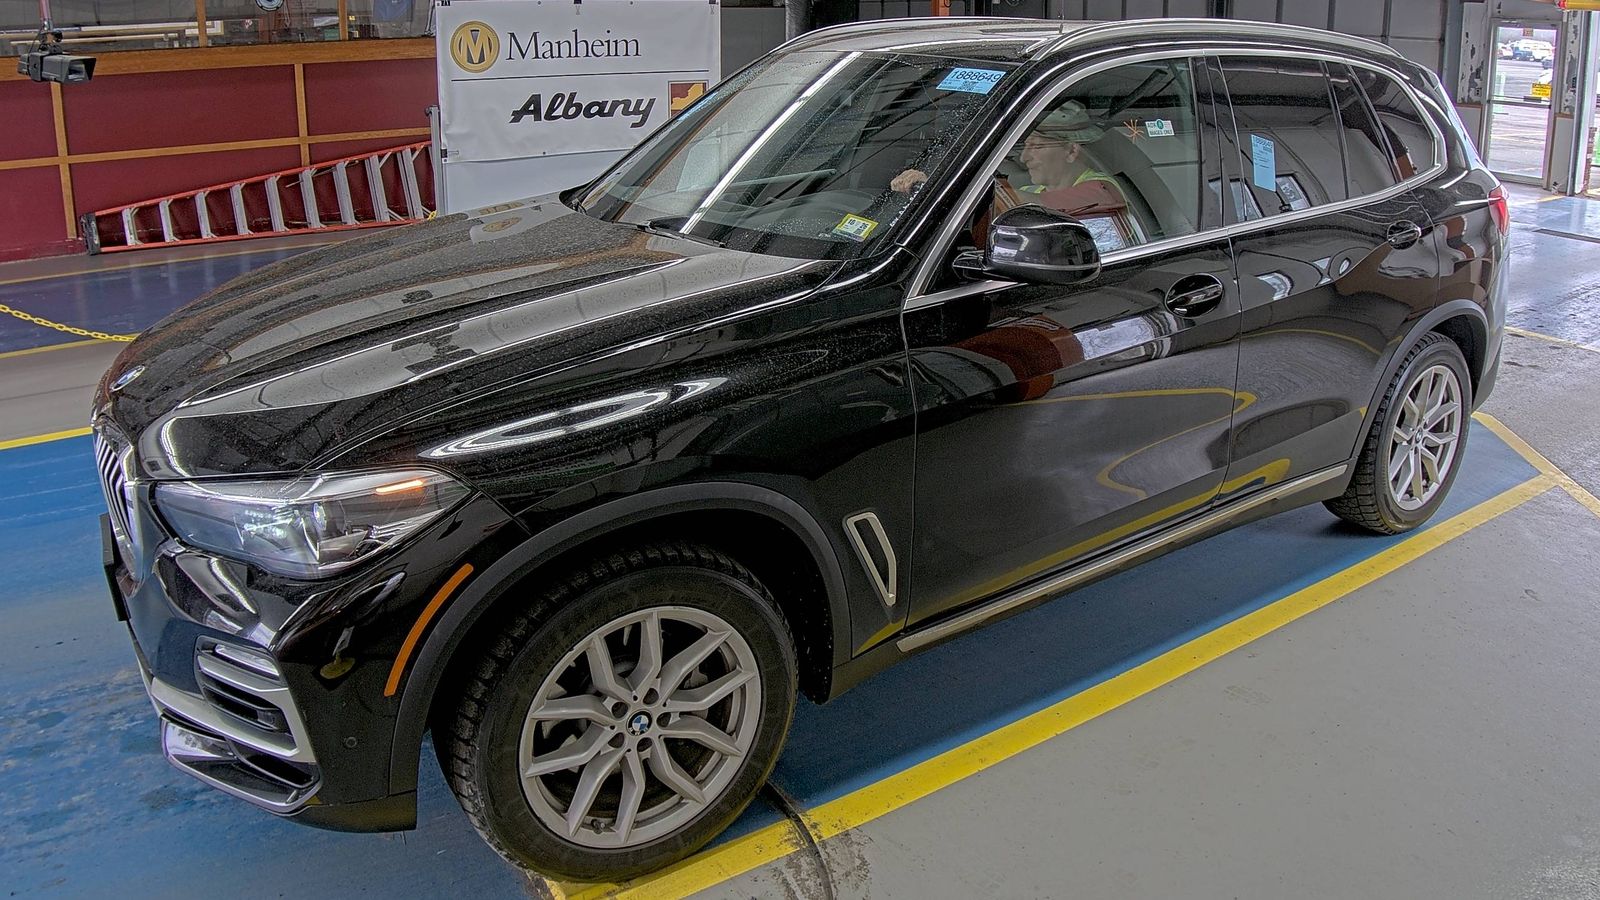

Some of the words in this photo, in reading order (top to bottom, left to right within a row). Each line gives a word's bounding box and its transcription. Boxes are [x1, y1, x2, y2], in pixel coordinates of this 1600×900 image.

[506, 29, 642, 61] Manheim
[951, 70, 1002, 83] 1888649
[509, 91, 656, 129] Albany
